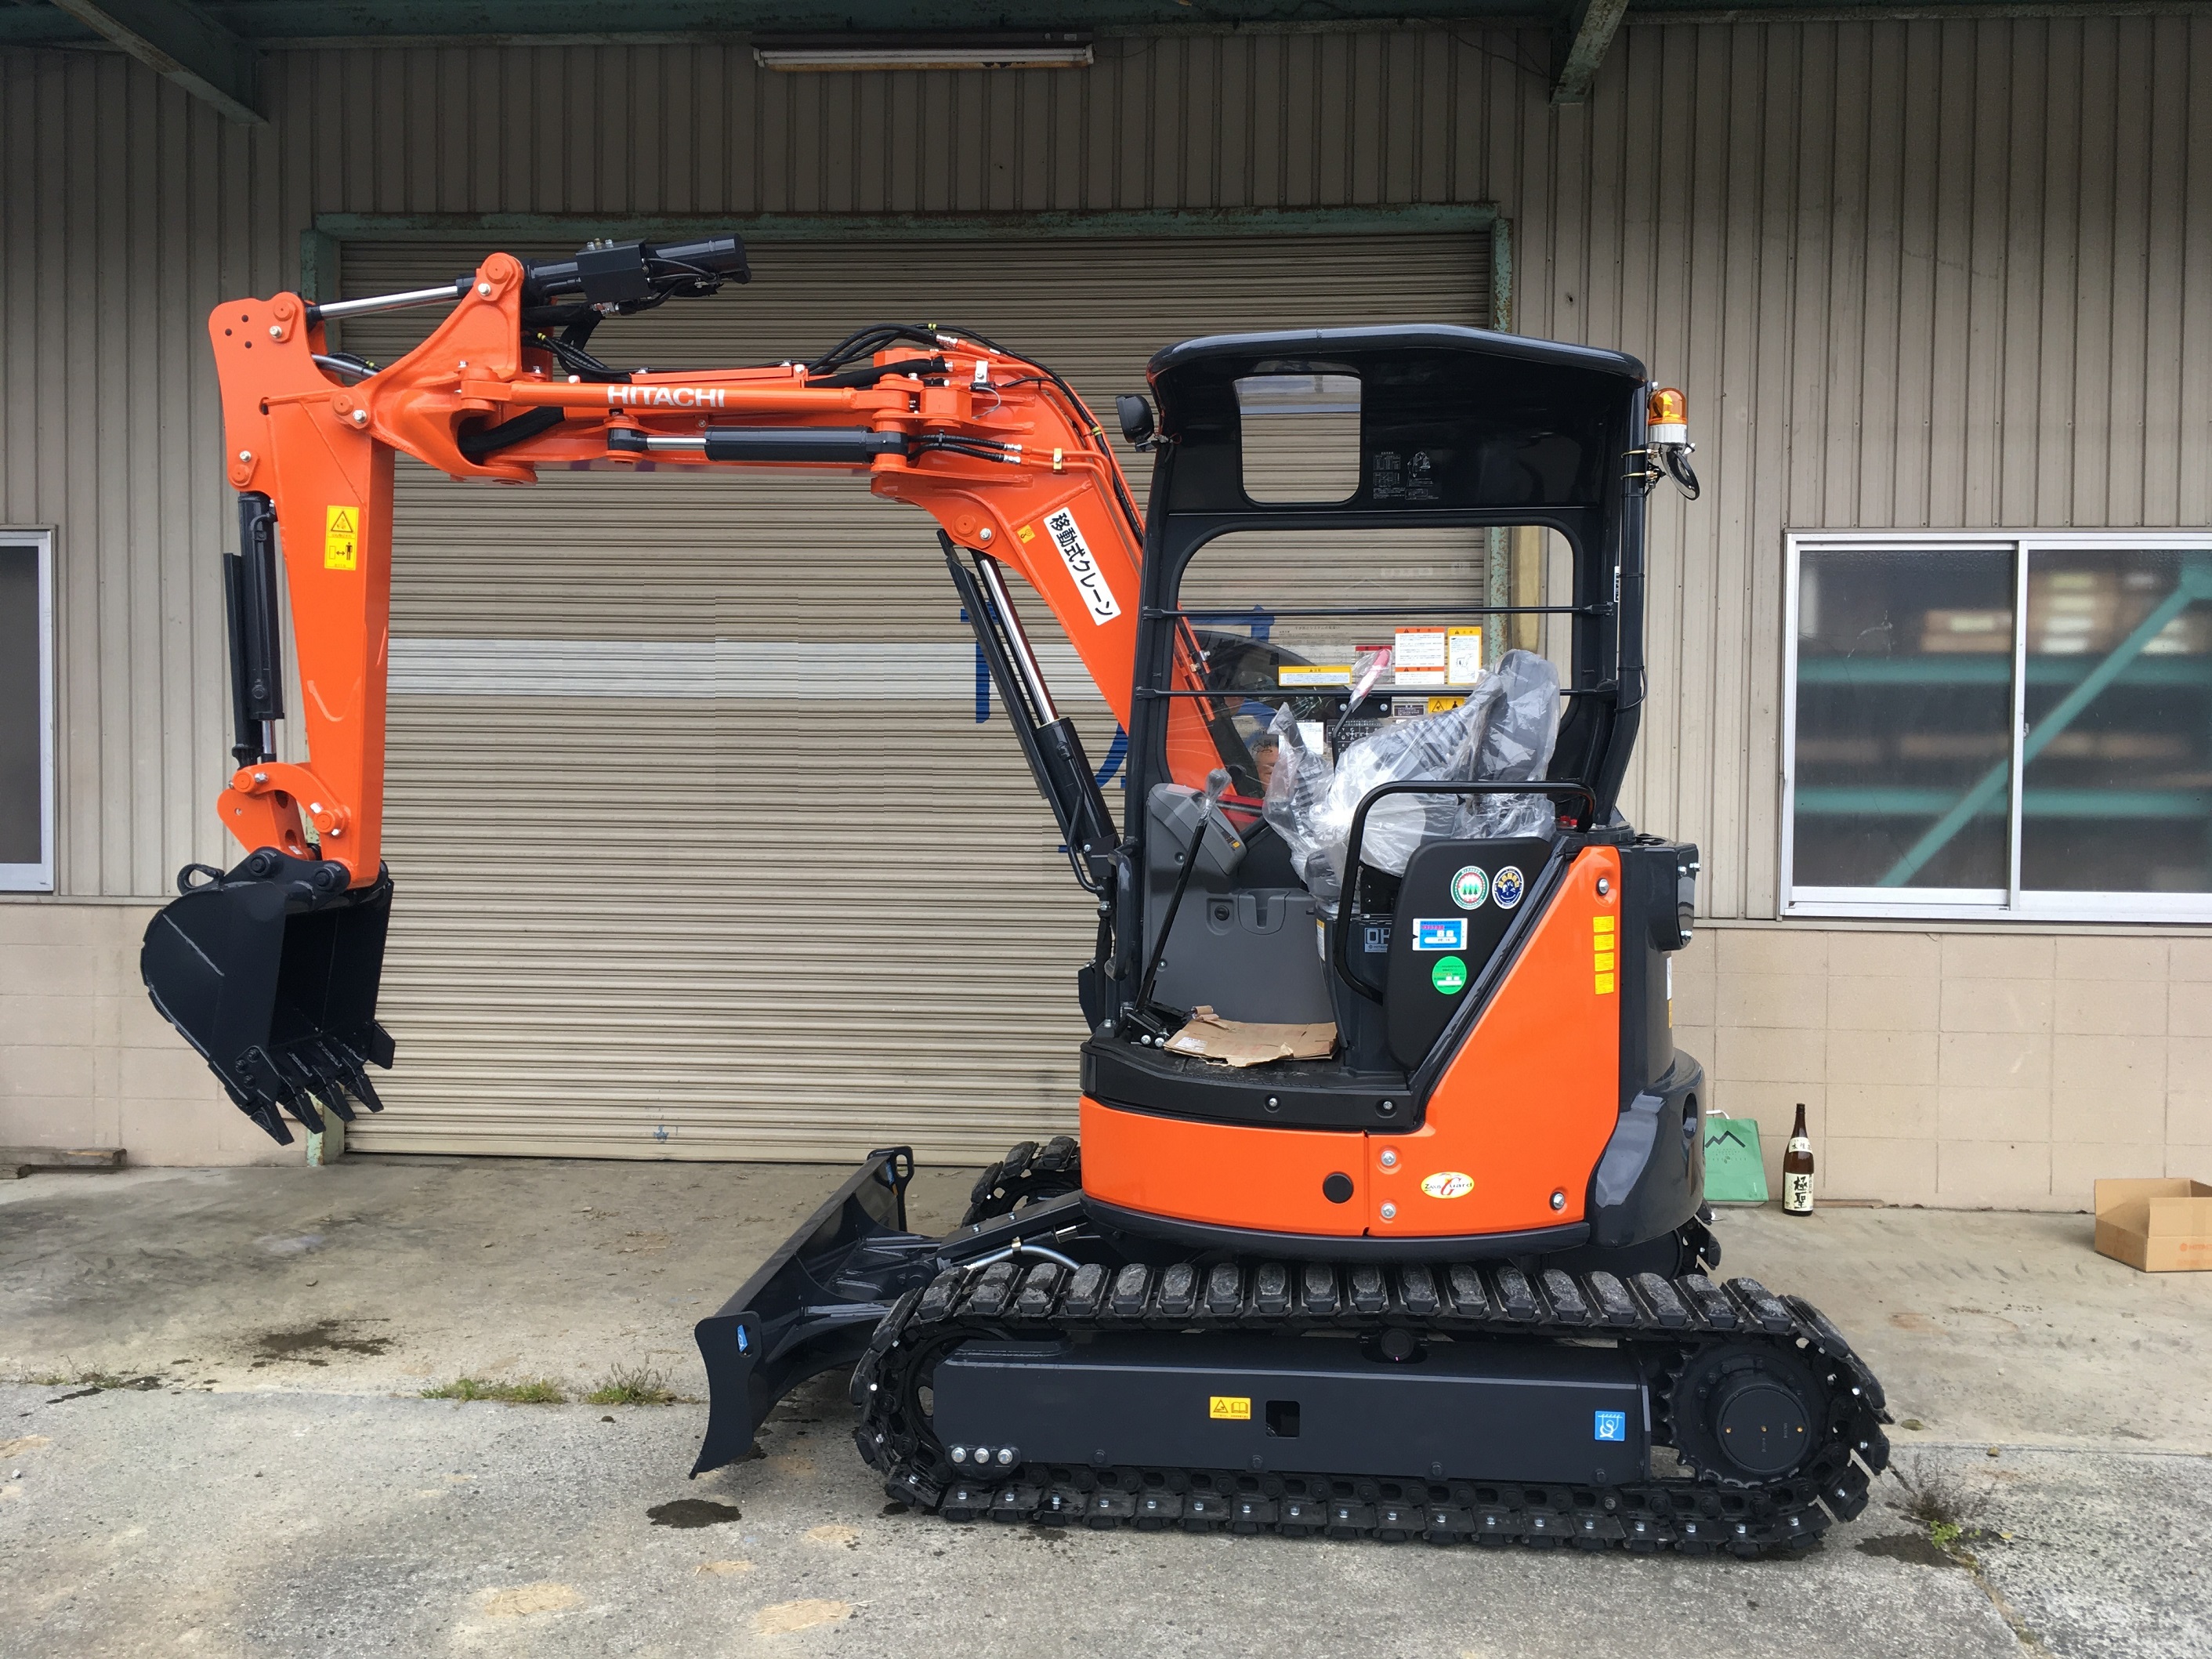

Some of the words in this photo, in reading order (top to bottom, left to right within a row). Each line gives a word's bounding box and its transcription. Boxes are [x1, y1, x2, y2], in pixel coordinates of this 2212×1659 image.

[607, 386, 725, 408] HITACHI
[1049, 512, 1113, 616] 移動式クレーン
[1794, 1175, 1808, 1209] 極聖
